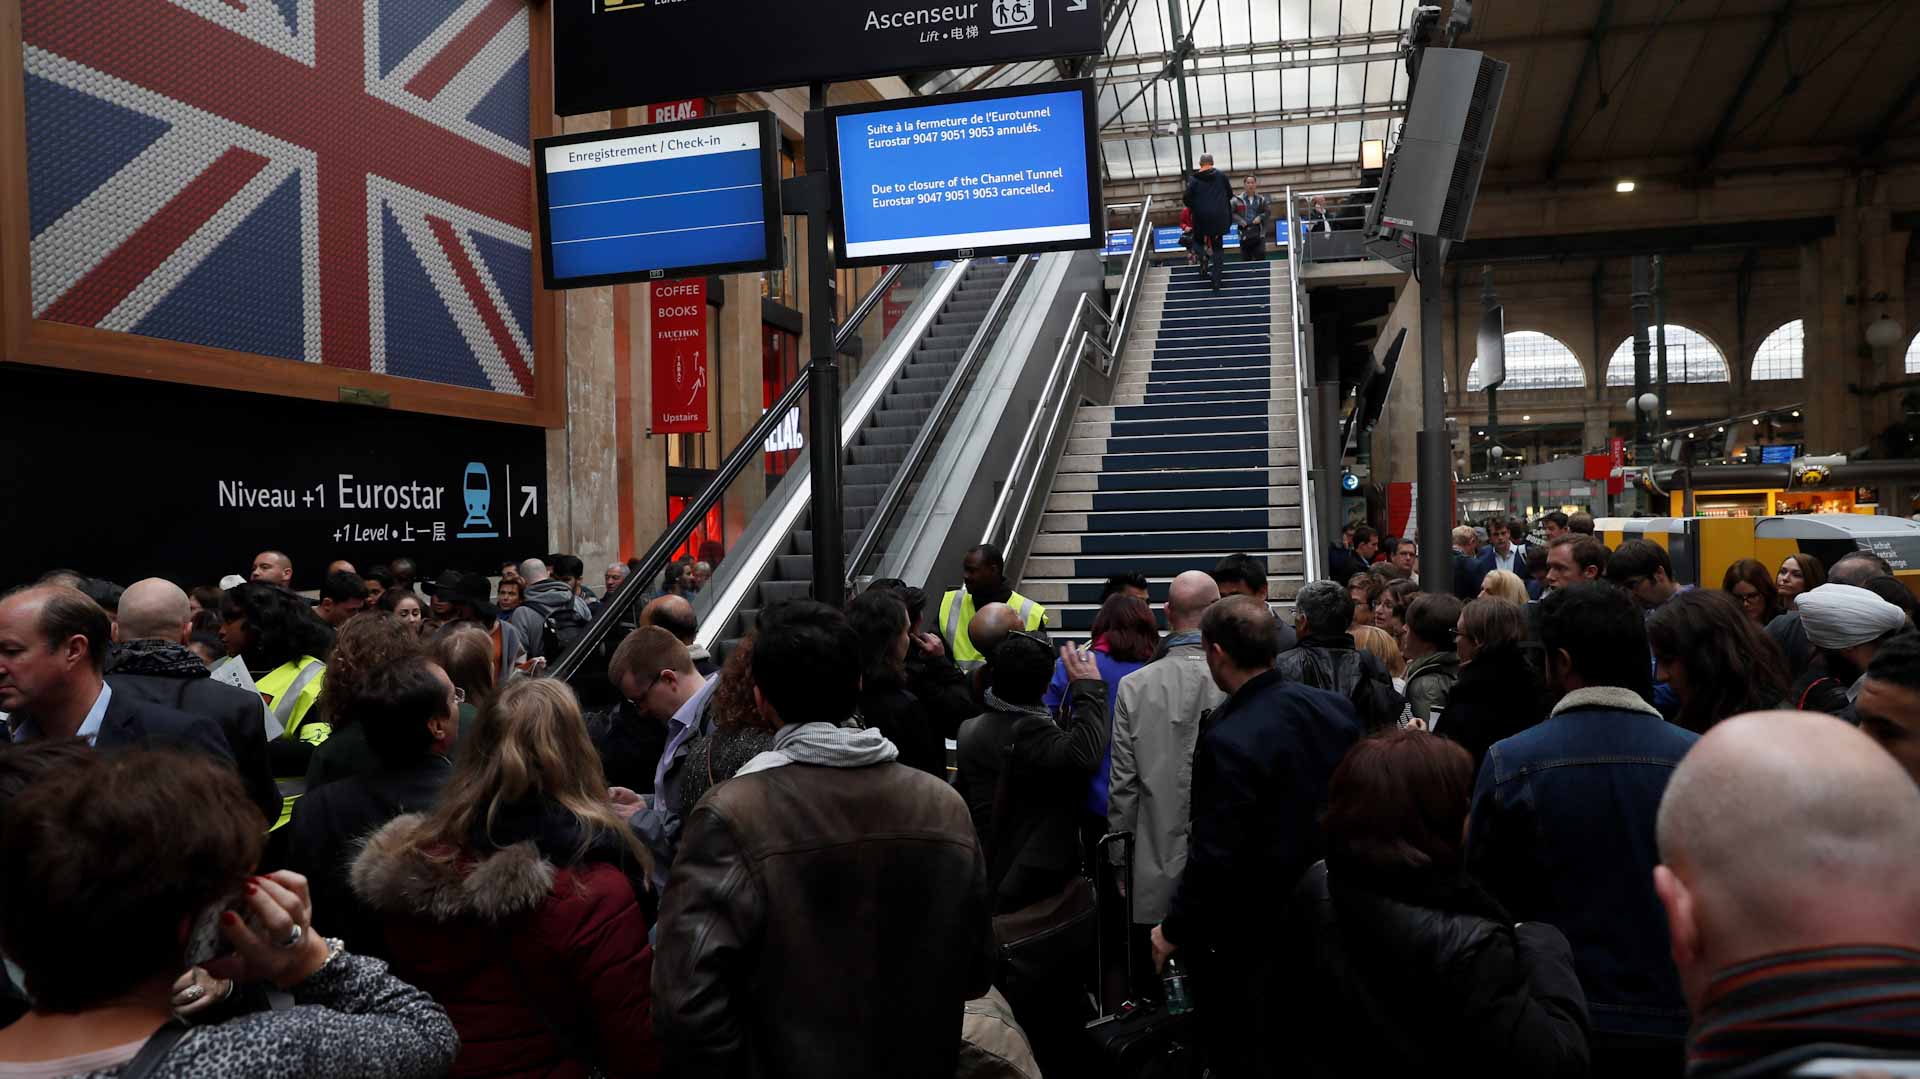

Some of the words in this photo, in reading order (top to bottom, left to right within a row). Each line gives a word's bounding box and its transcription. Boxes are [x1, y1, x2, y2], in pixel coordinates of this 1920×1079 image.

[864, 3, 978, 31] Ascenseur
[920, 31, 940, 43] Lift
[951, 25, 979, 40] 电梯
[867, 124, 893, 135] Suite
[896, 122, 902, 132] à
[904, 121, 914, 131] la
[916, 117, 968, 131] fermeture
[970, 113, 983, 124] de
[986, 107, 1051, 123] l'Eurotunnel
[868, 136, 911, 149] Eurostar
[913, 132, 938, 144] 9047
[941, 130, 966, 141] 9051
[969, 127, 994, 138] 9053
[997, 123, 1041, 136] annulés.
[569, 143, 657, 163] Enregistrement
[668, 135, 721, 151] Check-in
[872, 184, 892, 195] Due
[895, 182, 905, 192] to
[908, 179, 945, 192] closure
[948, 177, 959, 187] of
[961, 174, 979, 186] the
[981, 170, 1023, 184] Channel
[1026, 167, 1063, 180] Tunnel
[872, 196, 915, 208] Eurostar
[917, 193, 942, 204] 9047
[945, 190, 970, 201] 9051
[973, 187, 998, 198] 9053
[1001, 182, 1055, 197] cancelled.
[656, 285, 699, 297] COFFEE
[658, 305, 698, 318] BOOKS
[657, 329, 699, 339] FAUCHON
[663, 412, 698, 424] Upstairs
[218, 480, 296, 508] Niveau
[302, 483, 325, 508] +1
[338, 474, 445, 510] Eurostar
[333, 524, 351, 542] +1
[354, 523, 389, 542] Level
[401, 521, 446, 542] 上一层
